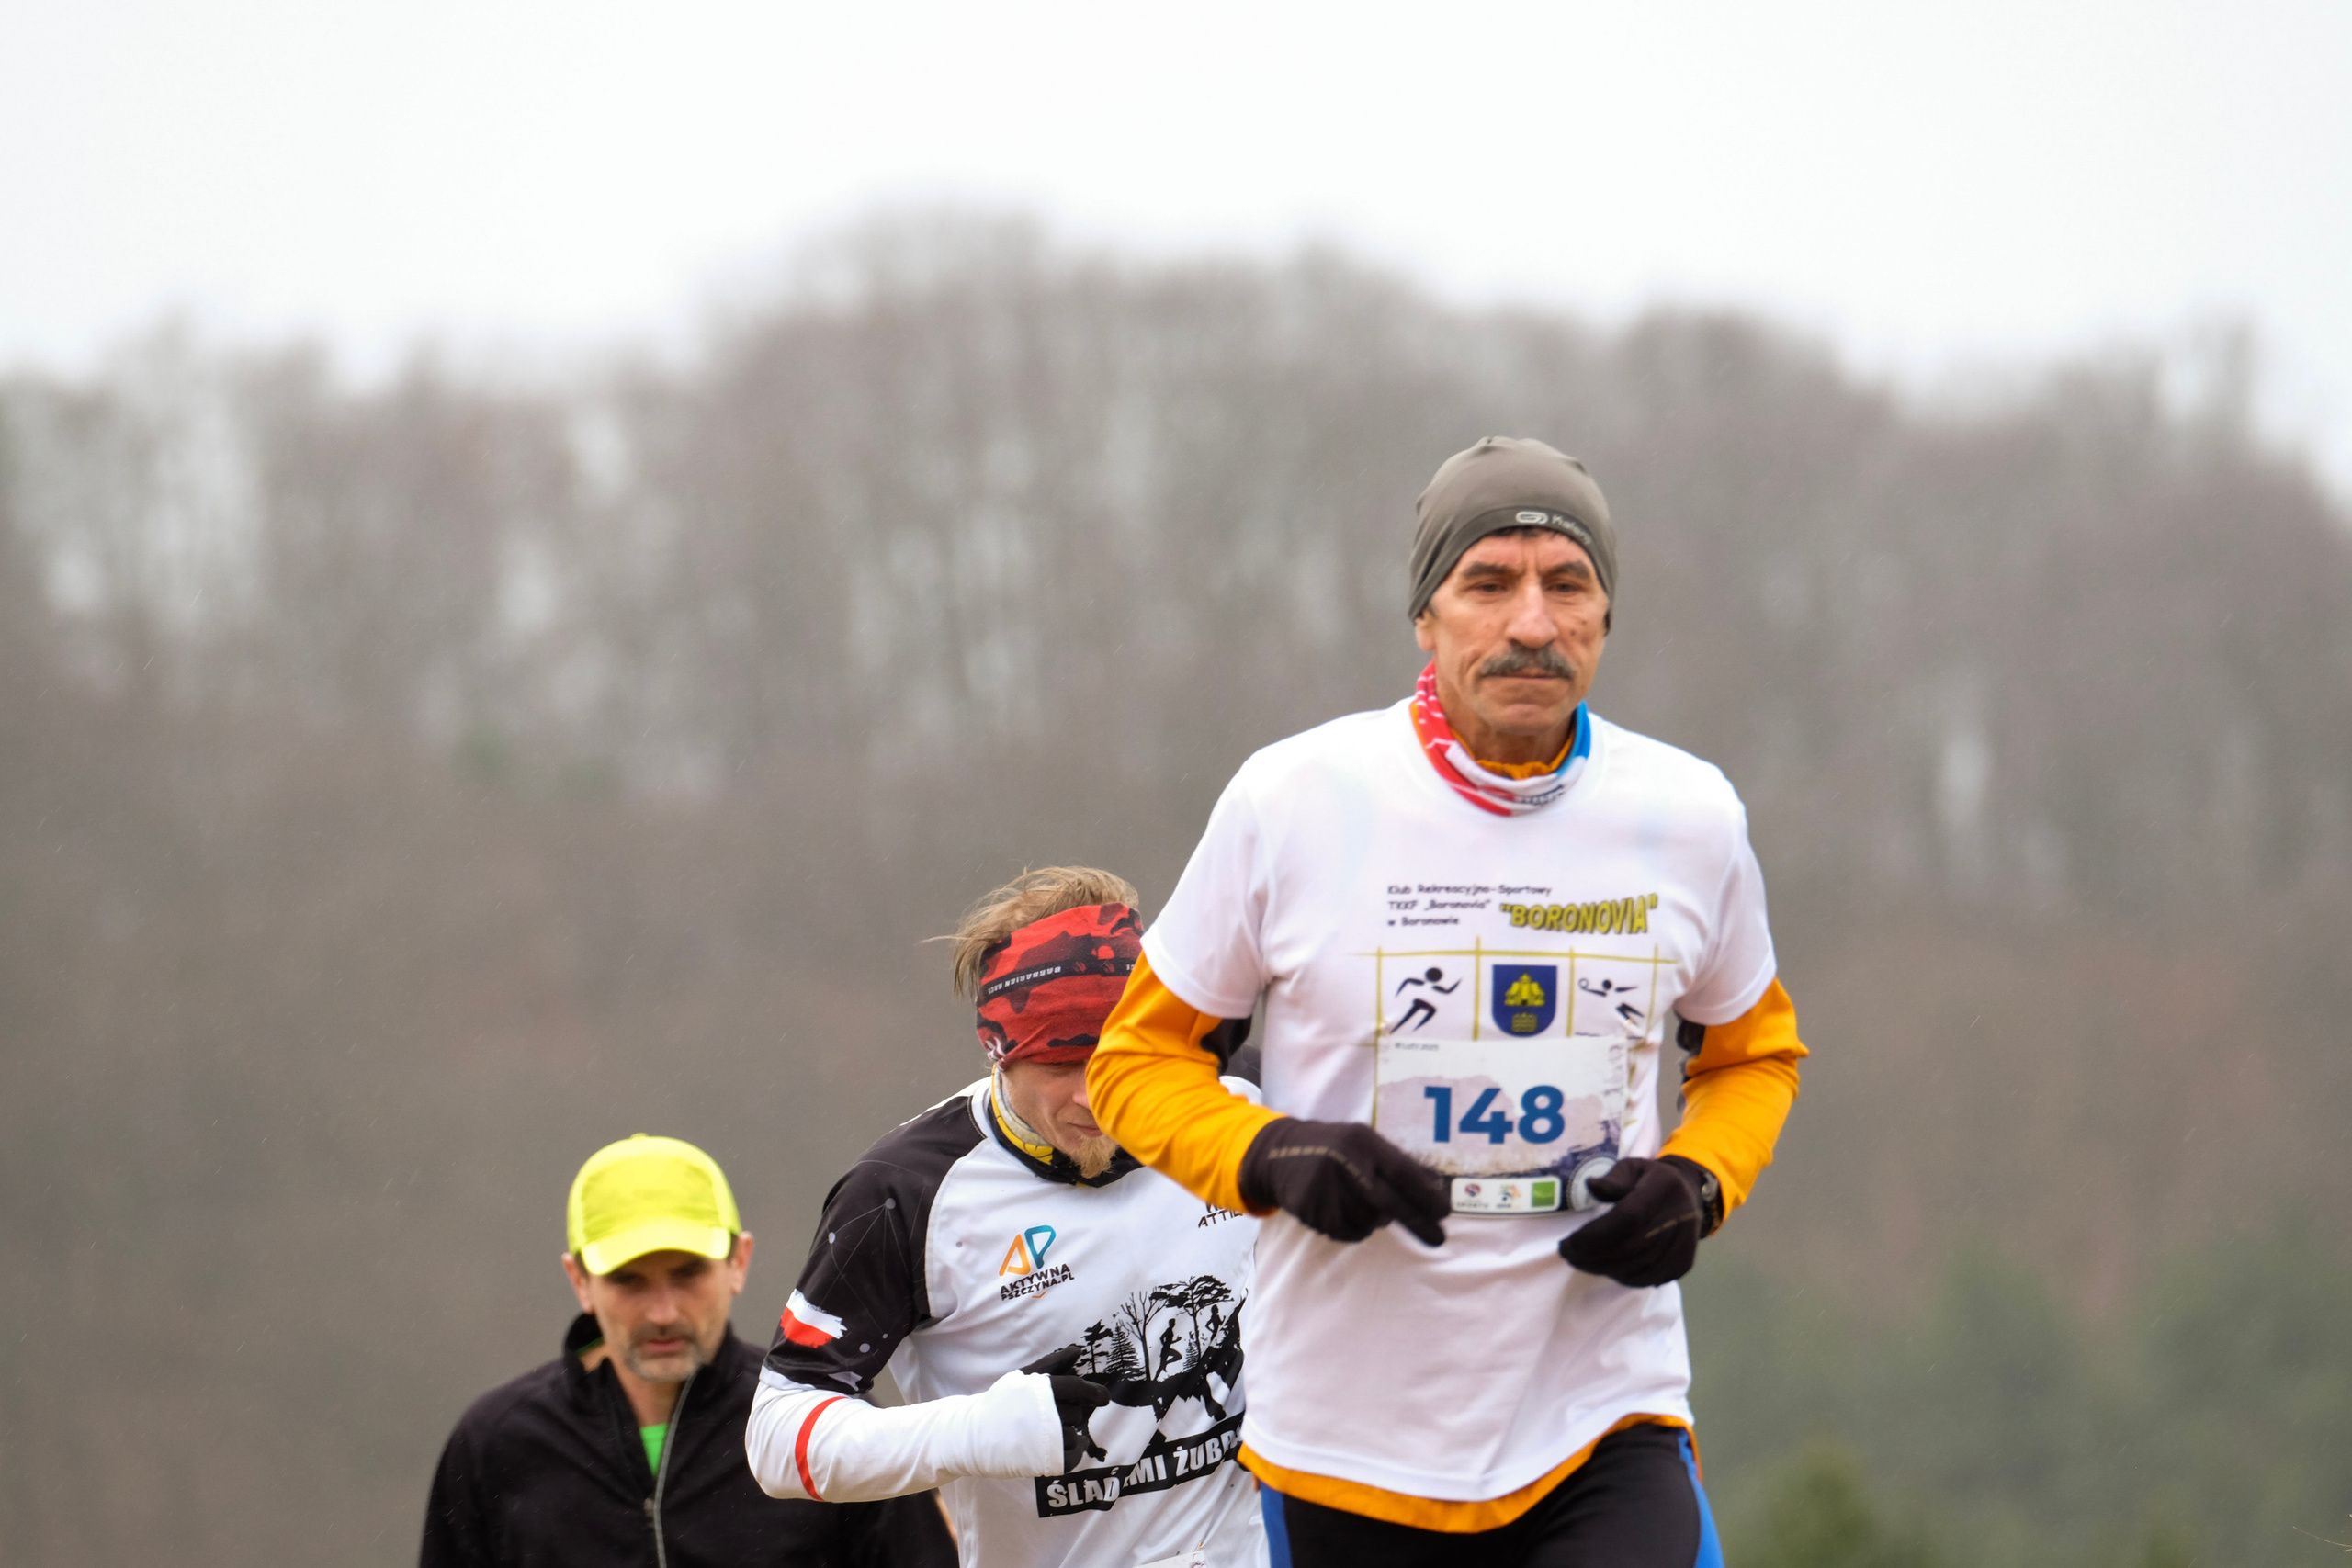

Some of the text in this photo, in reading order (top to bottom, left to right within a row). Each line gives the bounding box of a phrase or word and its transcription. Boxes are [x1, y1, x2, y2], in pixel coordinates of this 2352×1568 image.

[1387, 886, 1411, 895] Klub
[1424, 1085, 1566, 1145] 148
[1000, 1263, 1071, 1295] AKTYWNA
[1001, 1272, 1075, 1302] PSZCZYNA.PL
[1046, 1454, 1168, 1508] ŚLADMI
